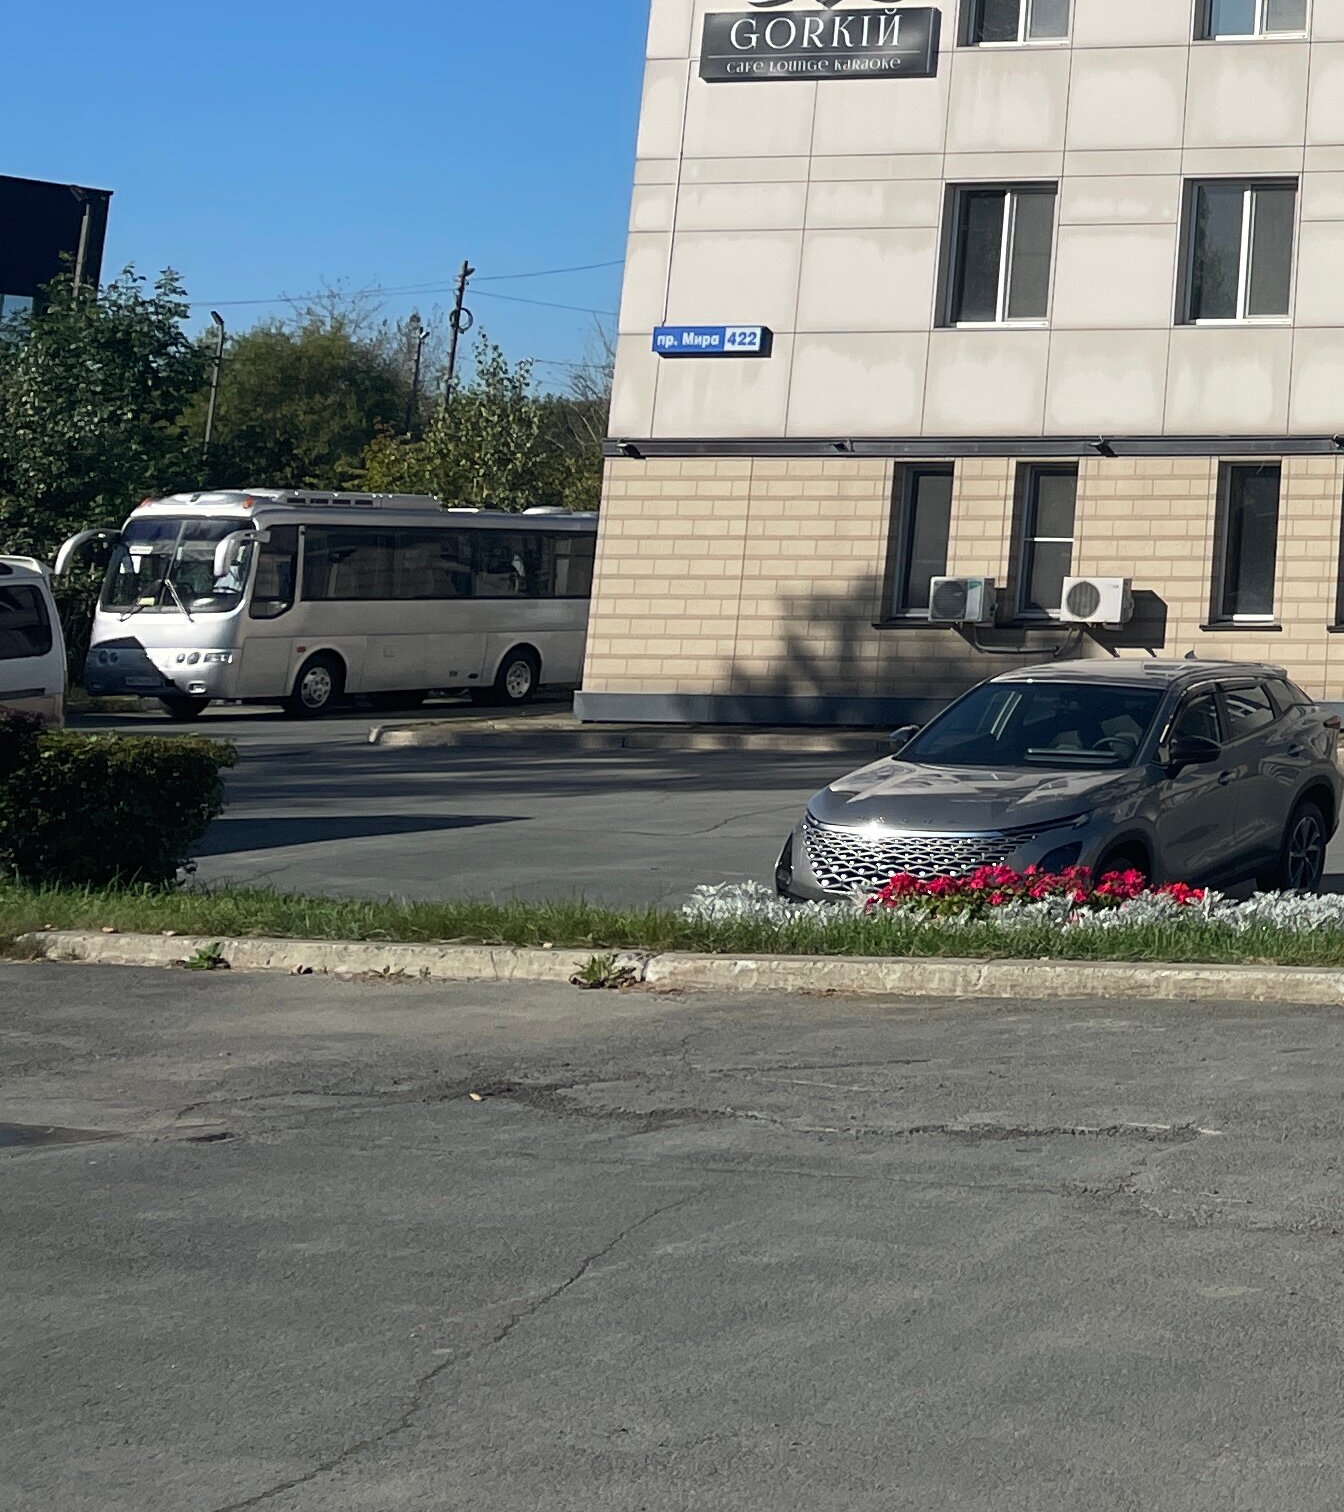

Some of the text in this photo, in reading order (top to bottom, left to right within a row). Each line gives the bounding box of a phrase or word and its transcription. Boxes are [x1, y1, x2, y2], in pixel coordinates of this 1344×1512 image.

[656, 332, 757, 348] пр. Мира 422
